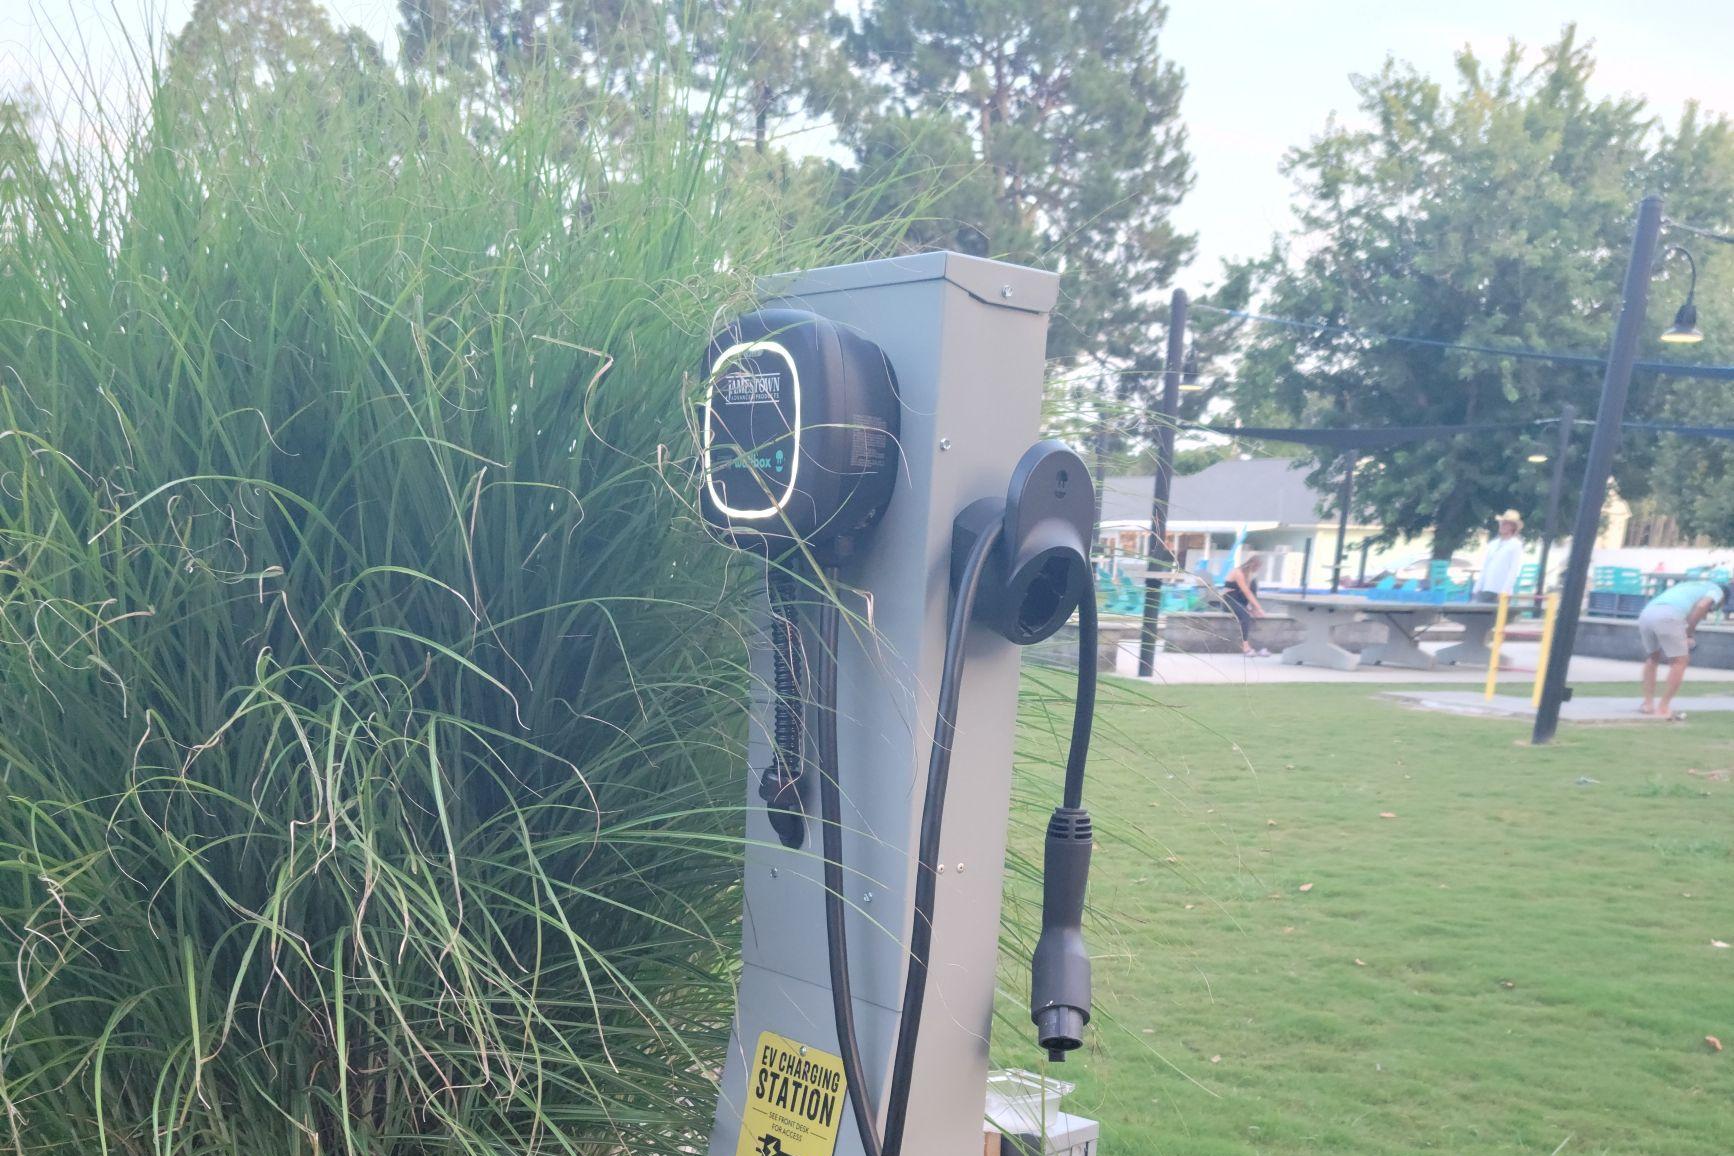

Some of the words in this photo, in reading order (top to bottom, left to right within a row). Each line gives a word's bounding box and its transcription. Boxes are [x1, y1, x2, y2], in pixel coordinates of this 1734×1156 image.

[728, 377, 780, 401] JAMESTOWN
[762, 1045, 777, 1067] EV
[779, 1052, 840, 1092] CHARGING
[756, 1068, 836, 1127] STATION
[769, 1111, 778, 1121] SEE
[778, 1115, 796, 1128] FRONT
[795, 1122, 810, 1134] DESK
[771, 1123, 782, 1132] FOR
[782, 1128, 803, 1142] ACCESS
